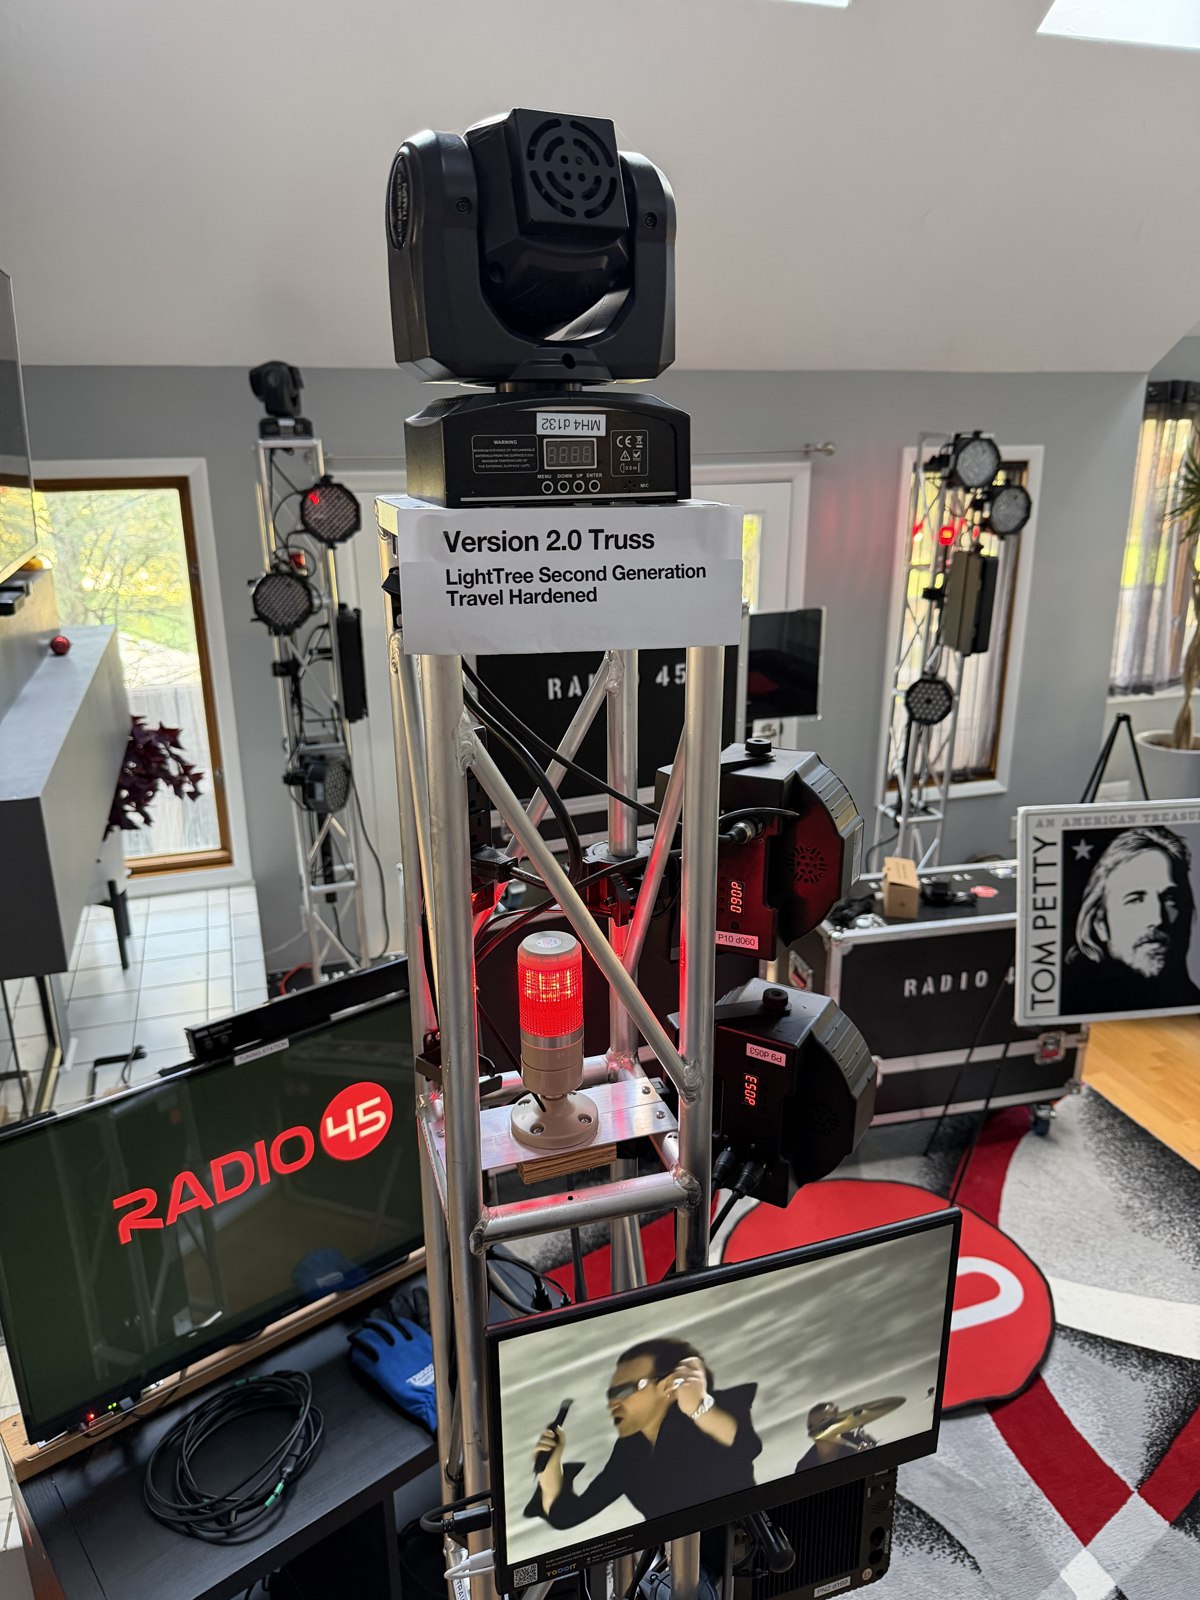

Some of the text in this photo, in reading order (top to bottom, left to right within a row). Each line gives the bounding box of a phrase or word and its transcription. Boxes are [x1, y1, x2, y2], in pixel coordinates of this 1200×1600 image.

[541, 418, 601, 431] MH4 d132
[442, 528, 655, 553] Version 2.0 Truss
[446, 563, 707, 589] LightTree Second Generation
[446, 587, 598, 607] Travel Hardened
[1035, 818, 1055, 828] AN
[1062, 814, 1137, 827] AMERICAN
[1031, 835, 1057, 1011] TOM PETTY
[718, 934, 756, 947] P10 d060
[903, 970, 989, 997] RADIO
[771, 1053, 782, 1063] P9
[113, 1096, 387, 1245] RADIO 45
[546, 1563, 577, 1577] YODOIT
